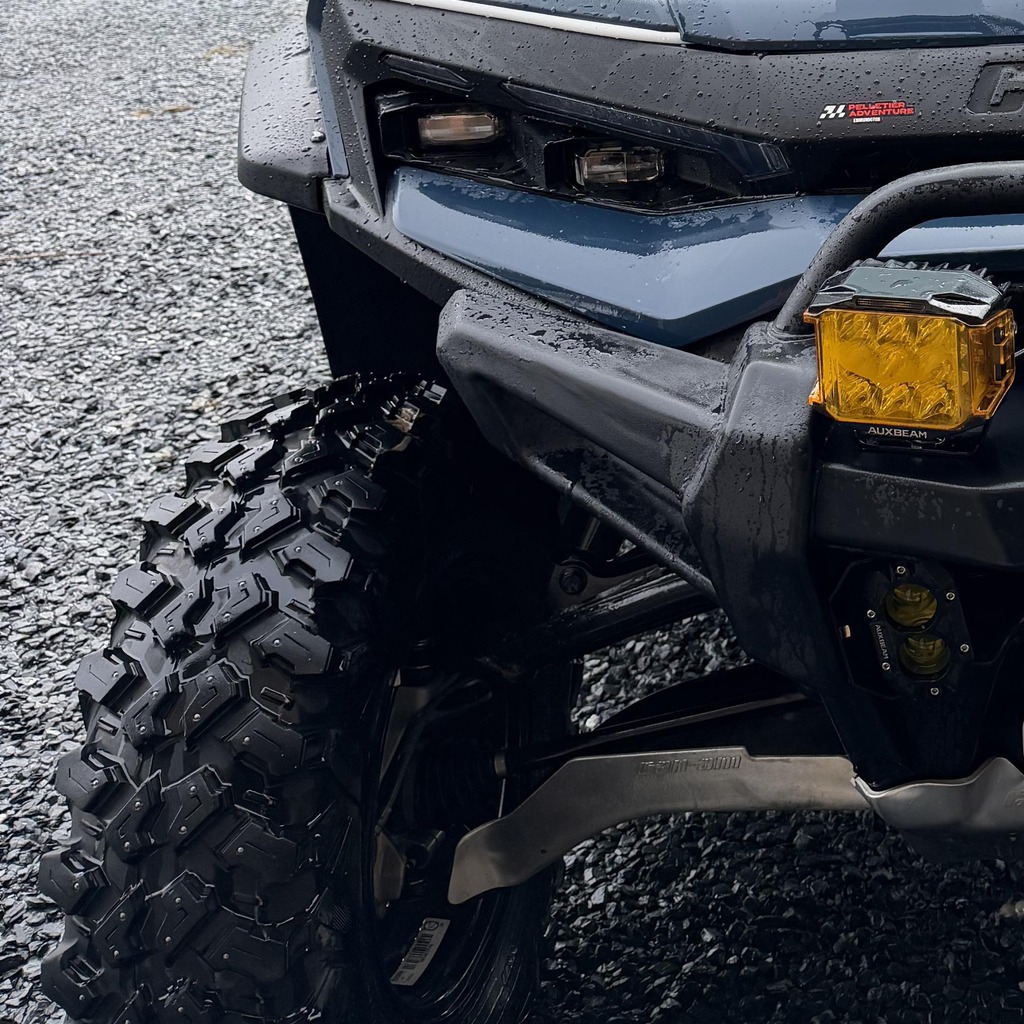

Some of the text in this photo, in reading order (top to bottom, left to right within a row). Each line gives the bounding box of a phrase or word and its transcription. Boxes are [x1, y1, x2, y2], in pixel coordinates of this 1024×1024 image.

[848, 101, 905, 111] PELLETIER
[848, 108, 914, 117] ADVENTURE
[867, 427, 928, 439] AUXBEAM
[874, 624, 889, 660] AUXBEAM
